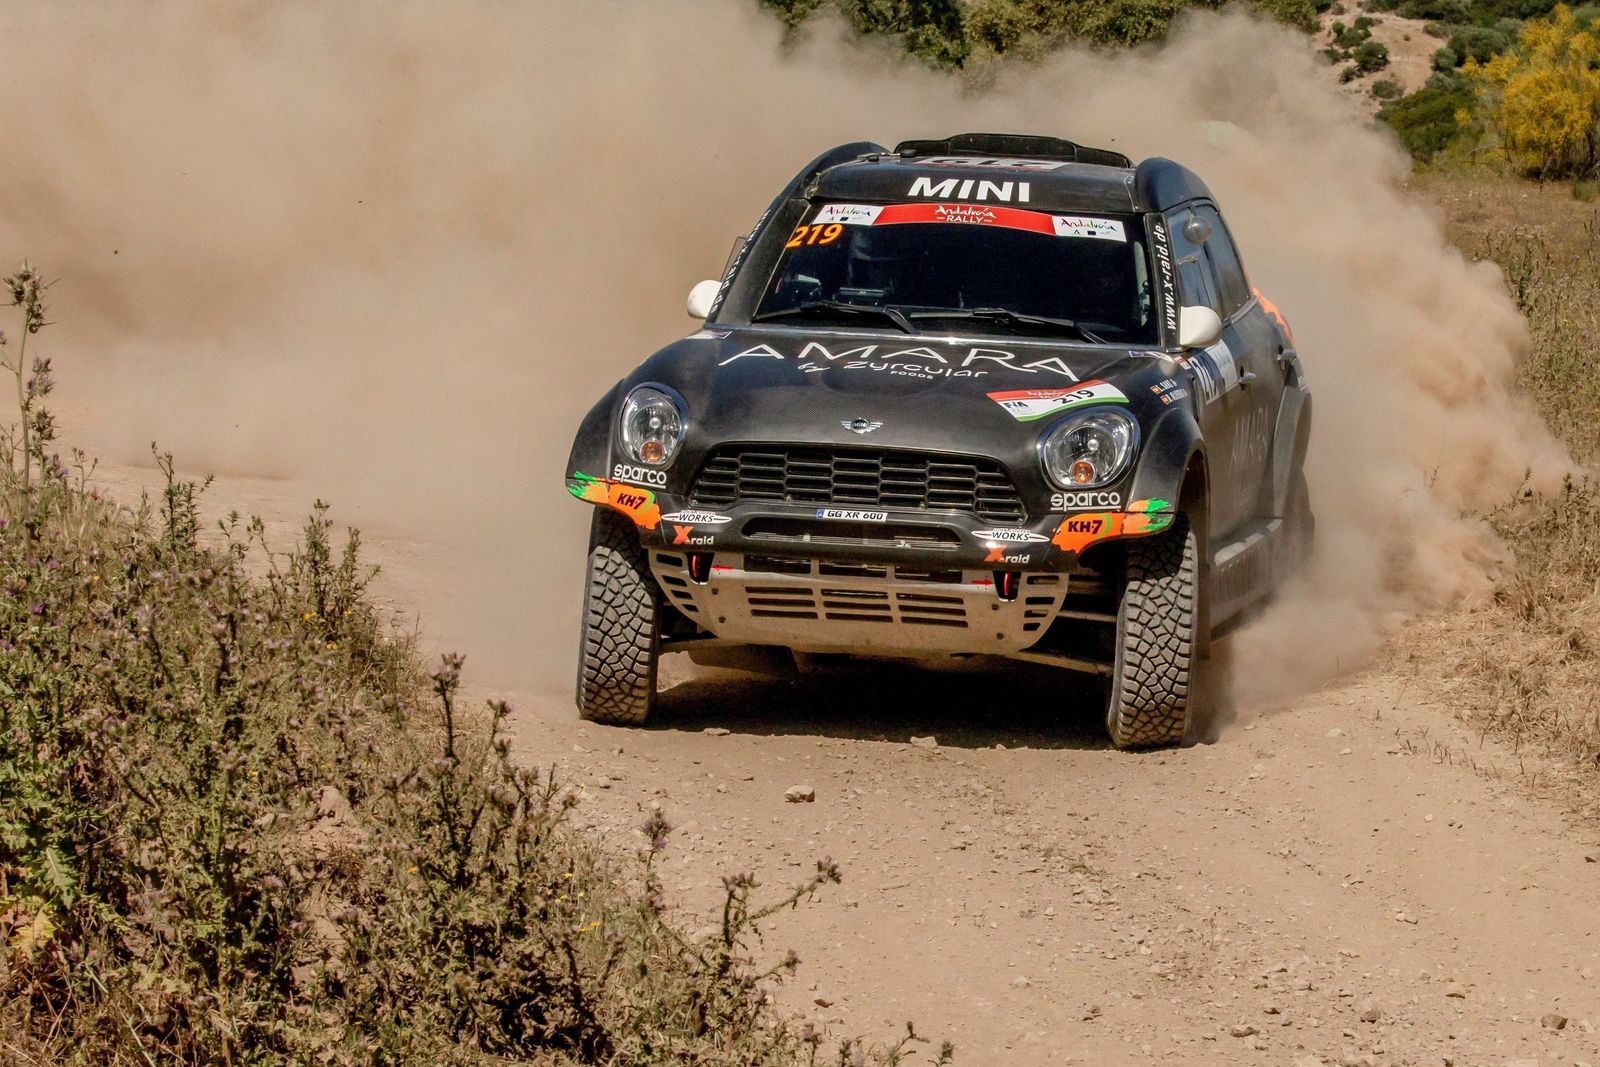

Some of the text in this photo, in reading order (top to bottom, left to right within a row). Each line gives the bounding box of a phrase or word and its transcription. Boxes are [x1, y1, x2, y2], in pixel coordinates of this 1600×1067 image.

[907, 177, 1030, 202] MINI
[934, 205, 997, 218] Andalucía
[946, 215, 984, 223] RALLY
[785, 223, 844, 249] 219
[1153, 224, 1177, 331] www.x-raid.de
[717, 342, 1081, 382] AMARA
[843, 360, 989, 378] Zyrcular
[890, 371, 934, 380] FOODS
[1052, 389, 1095, 405] 219
[613, 463, 667, 486] sparco
[1050, 491, 1121, 511] sparco
[679, 513, 715, 523] WORKS
[827, 510, 842, 518] GG
[845, 511, 860, 519] XR
[672, 525, 715, 545] X-raid
[992, 531, 1030, 541] WORKS
[984, 544, 1031, 564] X-raid
